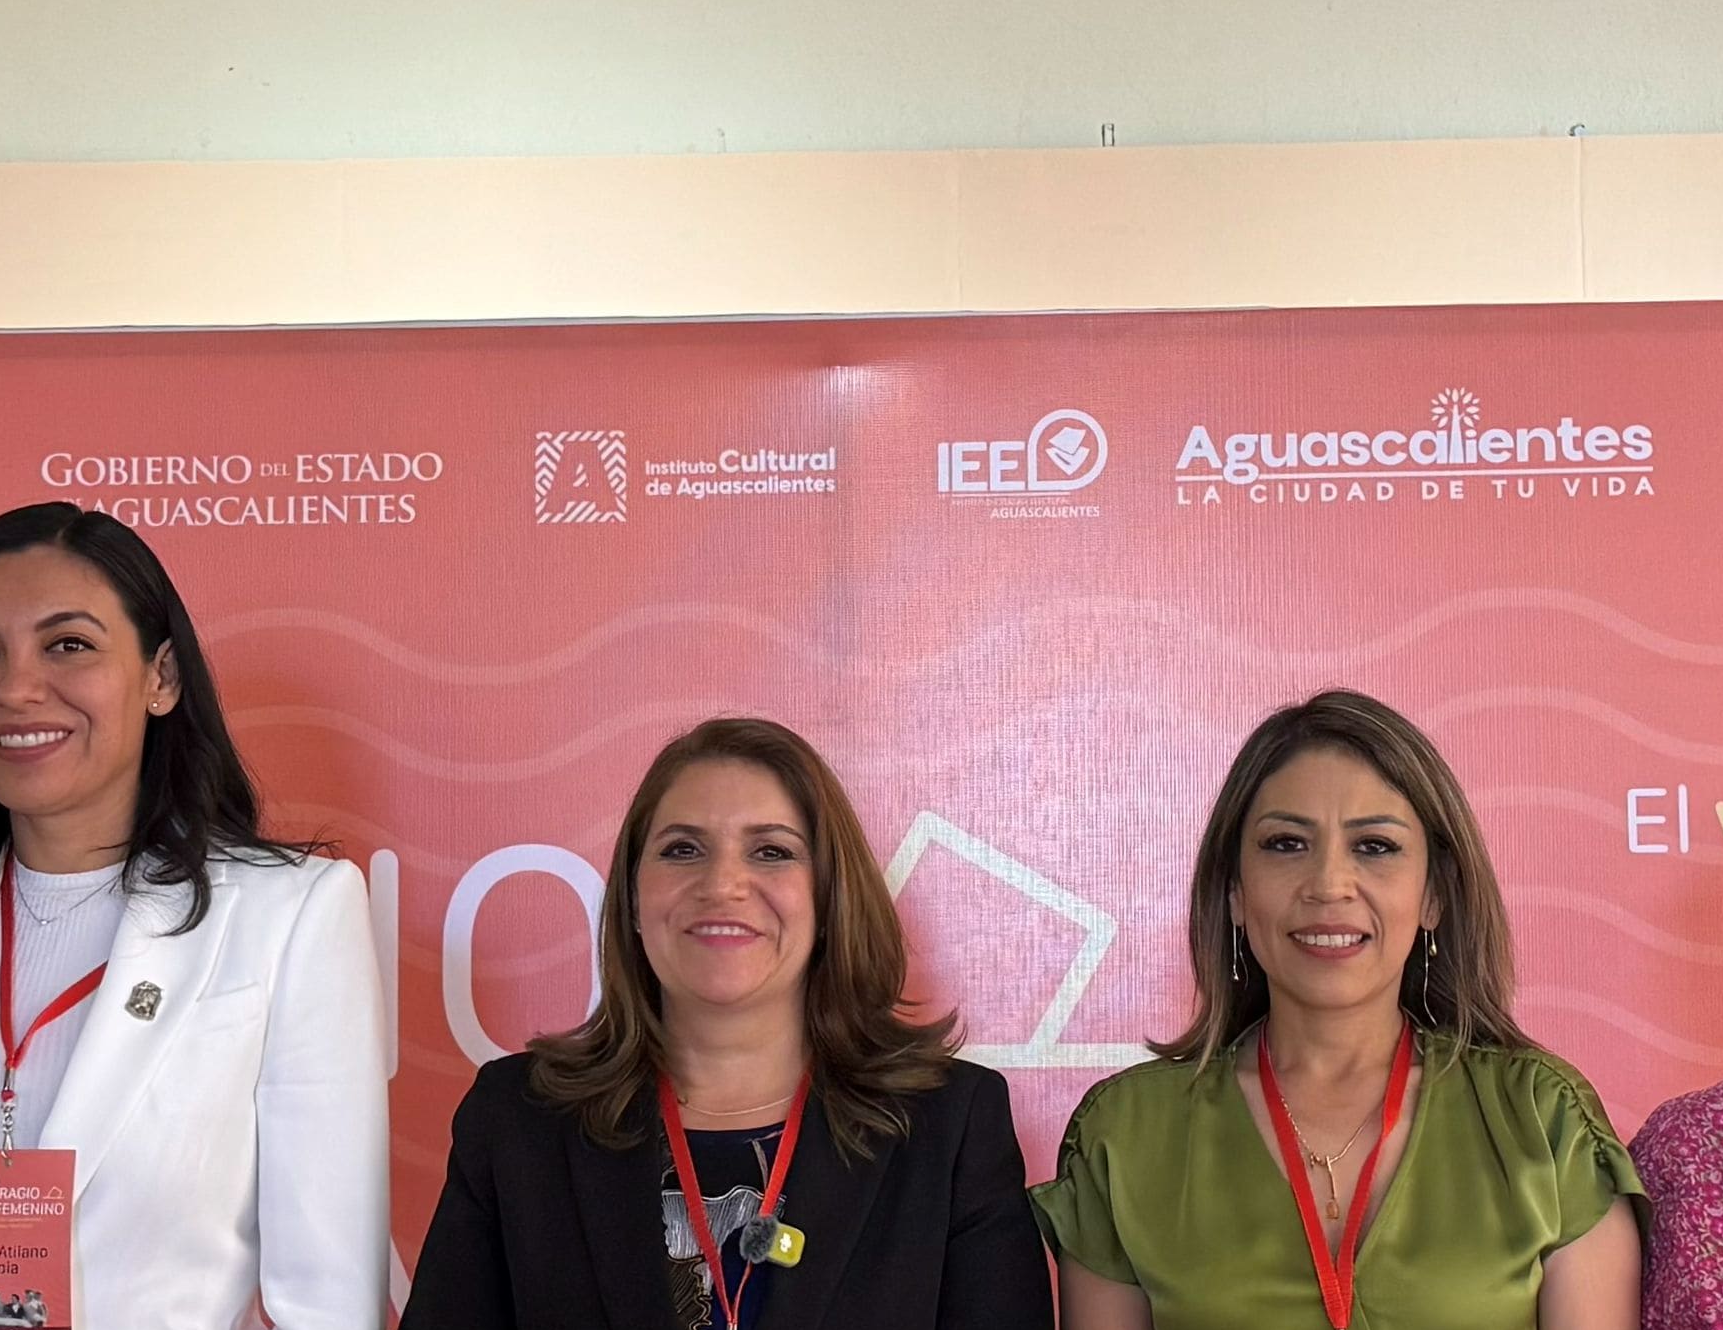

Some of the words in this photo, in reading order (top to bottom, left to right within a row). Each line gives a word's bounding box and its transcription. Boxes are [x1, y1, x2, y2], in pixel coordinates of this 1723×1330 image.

[645, 458, 717, 475] Instituto
[719, 447, 836, 474] Cultural
[1176, 412, 1653, 484] Aguascalientes
[41, 452, 252, 487] GOBIERNO
[260, 462, 291, 478] DEL
[295, 451, 443, 483] ESTADO
[645, 478, 671, 495] de
[676, 474, 836, 500] Aguascalientes
[1178, 485, 1221, 506] LA
[1250, 482, 1395, 503] CIUDAD
[1422, 480, 1464, 501] DE
[1492, 478, 1534, 499] TU
[1562, 476, 1655, 497] VIDA
[990, 506, 1100, 519] AGUASCALIENTES
[1625, 787, 1688, 854] El
